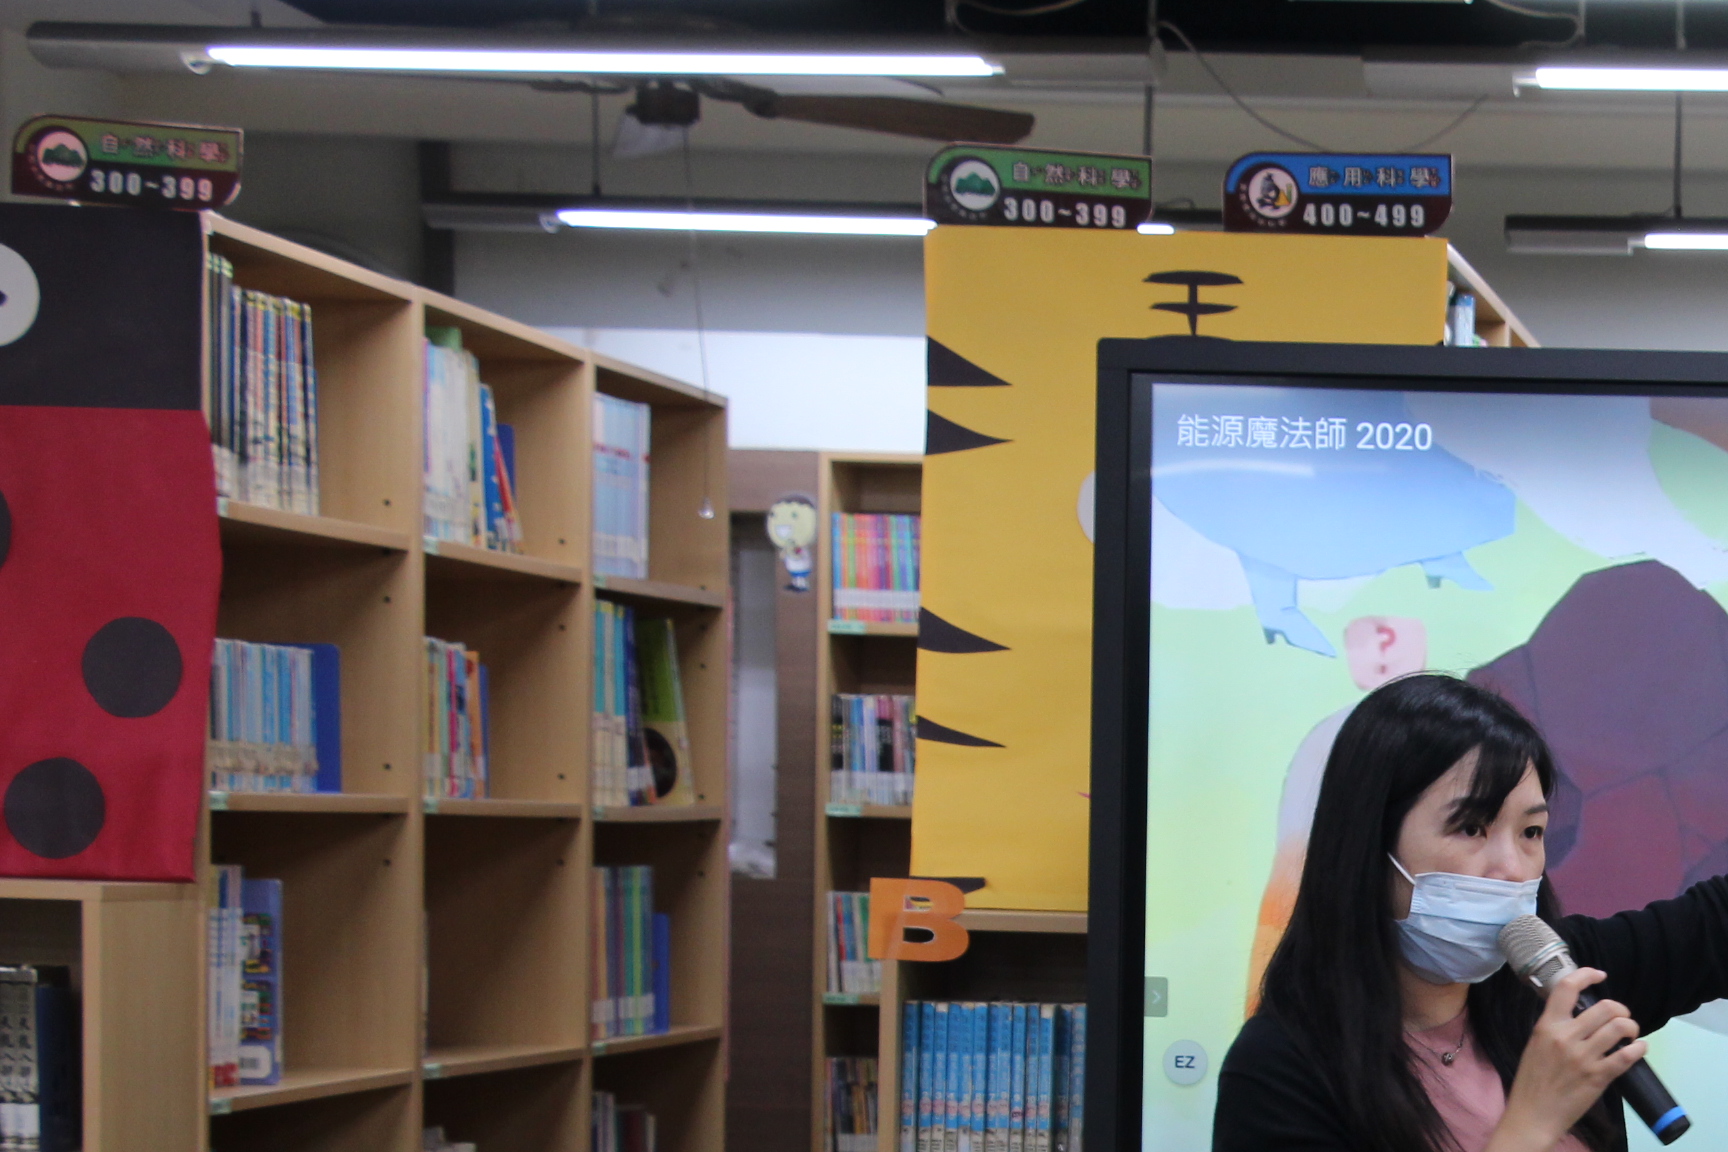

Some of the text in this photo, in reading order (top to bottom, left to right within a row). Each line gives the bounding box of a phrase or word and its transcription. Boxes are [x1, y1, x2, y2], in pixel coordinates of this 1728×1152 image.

[89, 168, 214, 203] 300~399
[1002, 196, 1127, 229] 300~399
[1302, 202, 1426, 228] 400~499
[1176, 413, 1433, 452] 能源魔法師 2020
[866, 876, 970, 963] B
[1173, 1055, 1197, 1070] EZ
